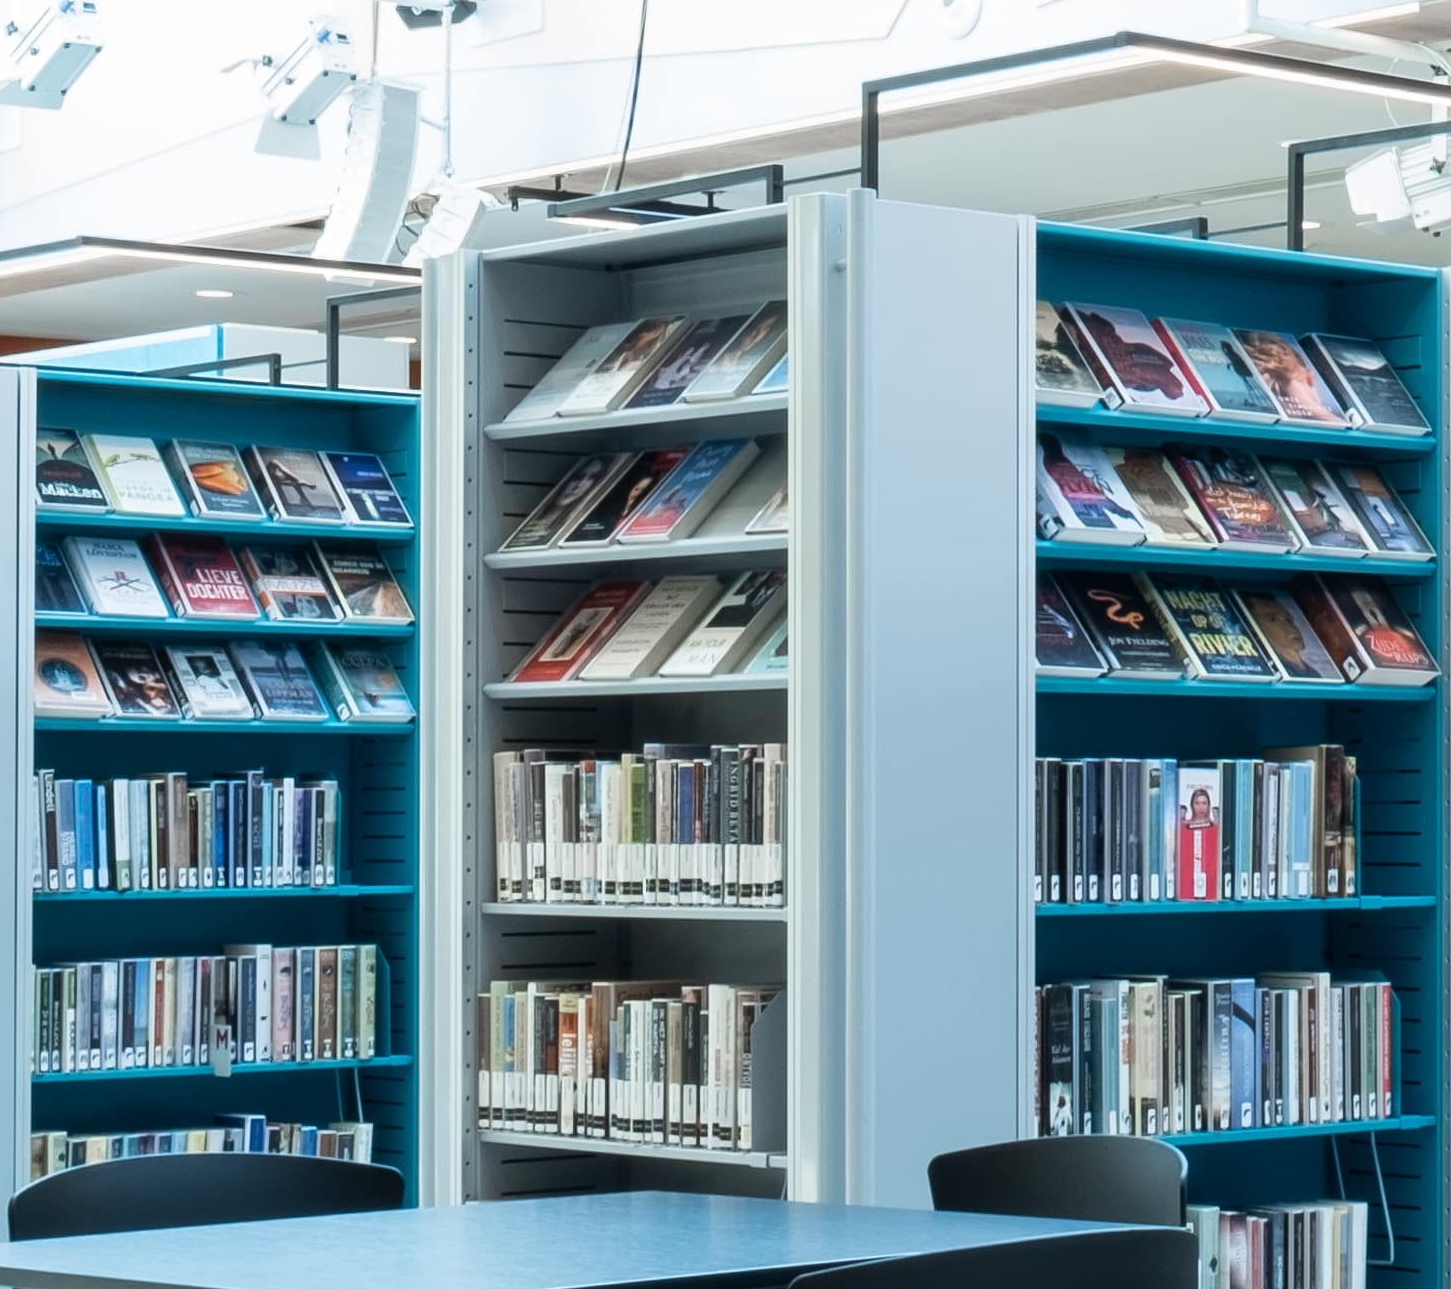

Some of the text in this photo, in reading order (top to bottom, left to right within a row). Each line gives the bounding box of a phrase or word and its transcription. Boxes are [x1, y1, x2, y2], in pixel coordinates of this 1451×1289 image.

[196, 569, 243, 585] LIEVE
[186, 583, 249, 600] DOCHTER
[1163, 590, 1226, 611] NACHT
[1189, 633, 1259, 657] RIVIER
[216, 1029, 229, 1050] M
